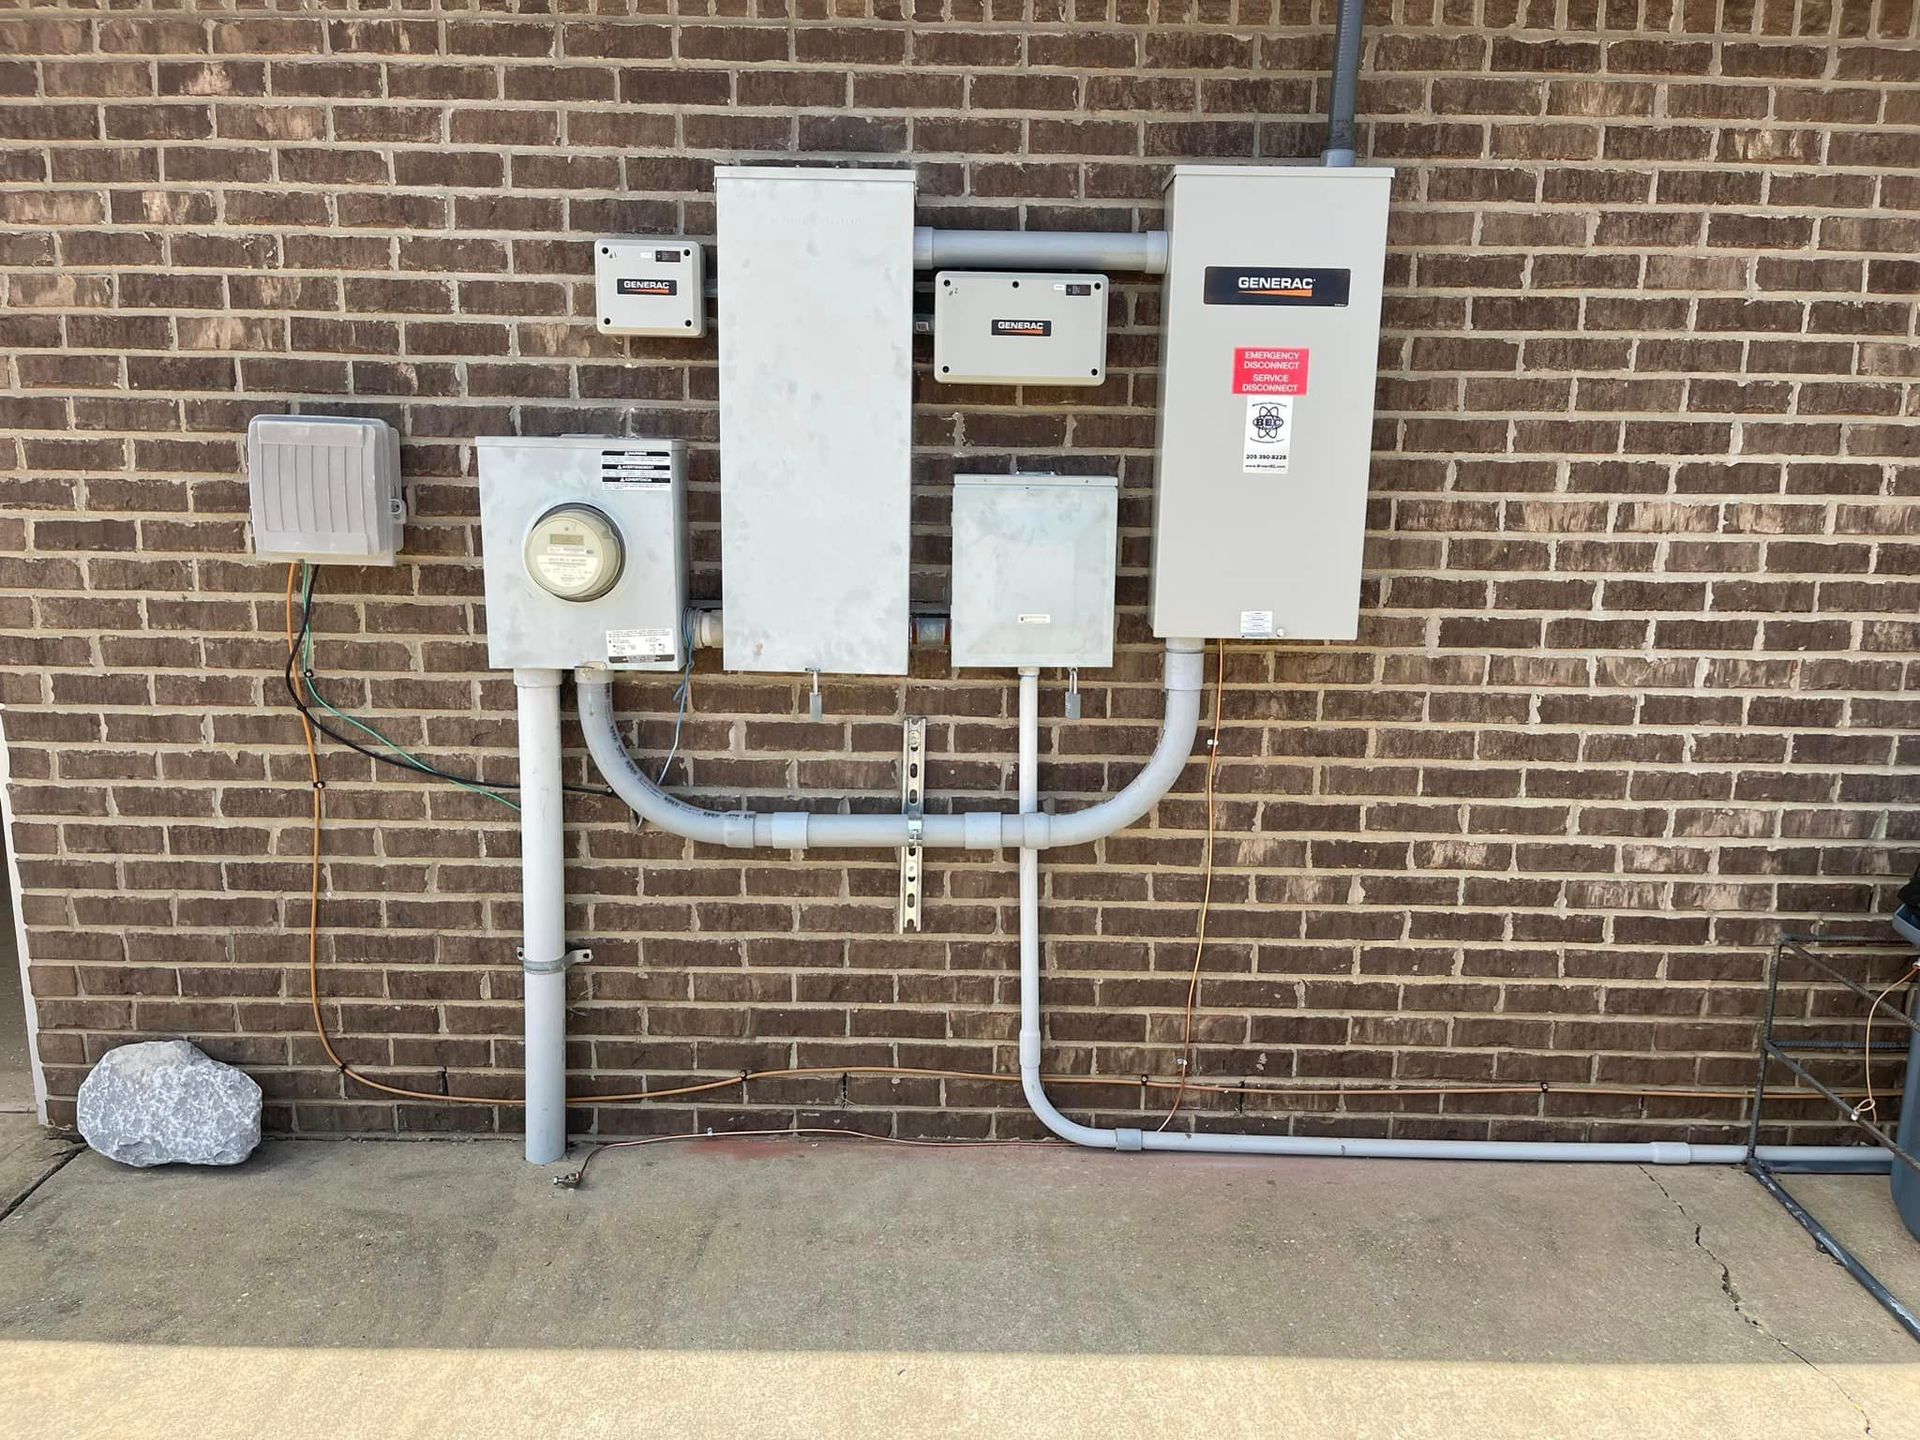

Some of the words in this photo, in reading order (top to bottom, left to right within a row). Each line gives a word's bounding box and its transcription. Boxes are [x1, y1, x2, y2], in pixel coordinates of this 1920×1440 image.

[623, 281, 670, 289] GENERAC
[1238, 277, 1314, 289] GENERAC
[997, 321, 1044, 329] GENERAC
[1245, 351, 1300, 360] EMERGENCY
[1244, 361, 1300, 369] DISCONNECT
[1253, 374, 1289, 382] SERVICE
[1242, 384, 1298, 392] DISCONNECT
